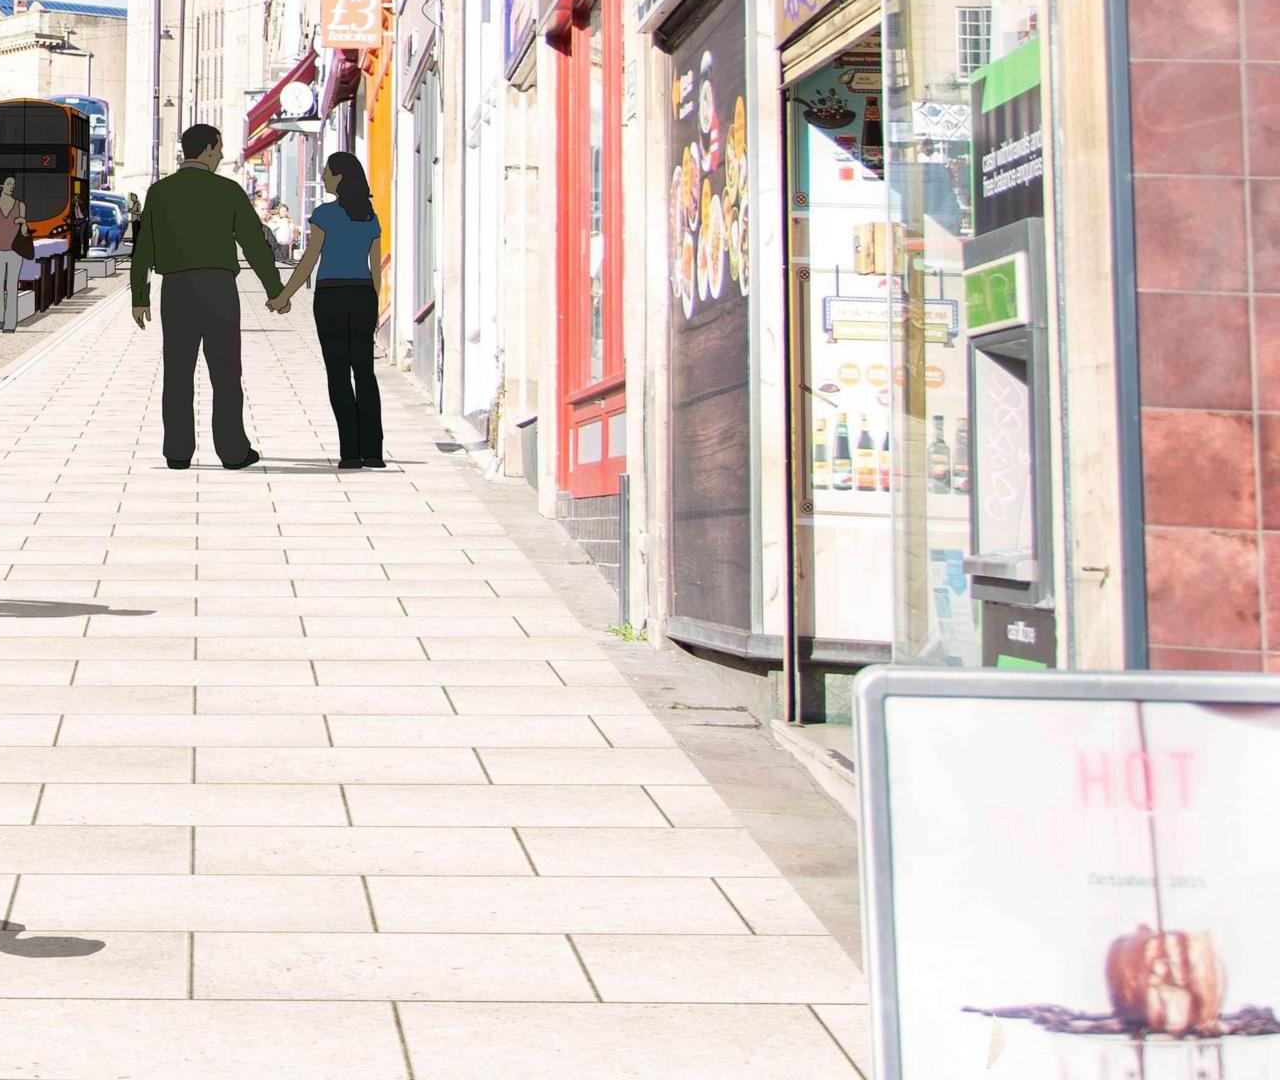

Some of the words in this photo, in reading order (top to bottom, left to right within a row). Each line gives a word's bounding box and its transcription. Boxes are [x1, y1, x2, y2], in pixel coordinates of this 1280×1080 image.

[328, 30, 377, 44] Bookshop
[42, 155, 50, 167] 2
[1077, 751, 1195, 811] HOT
